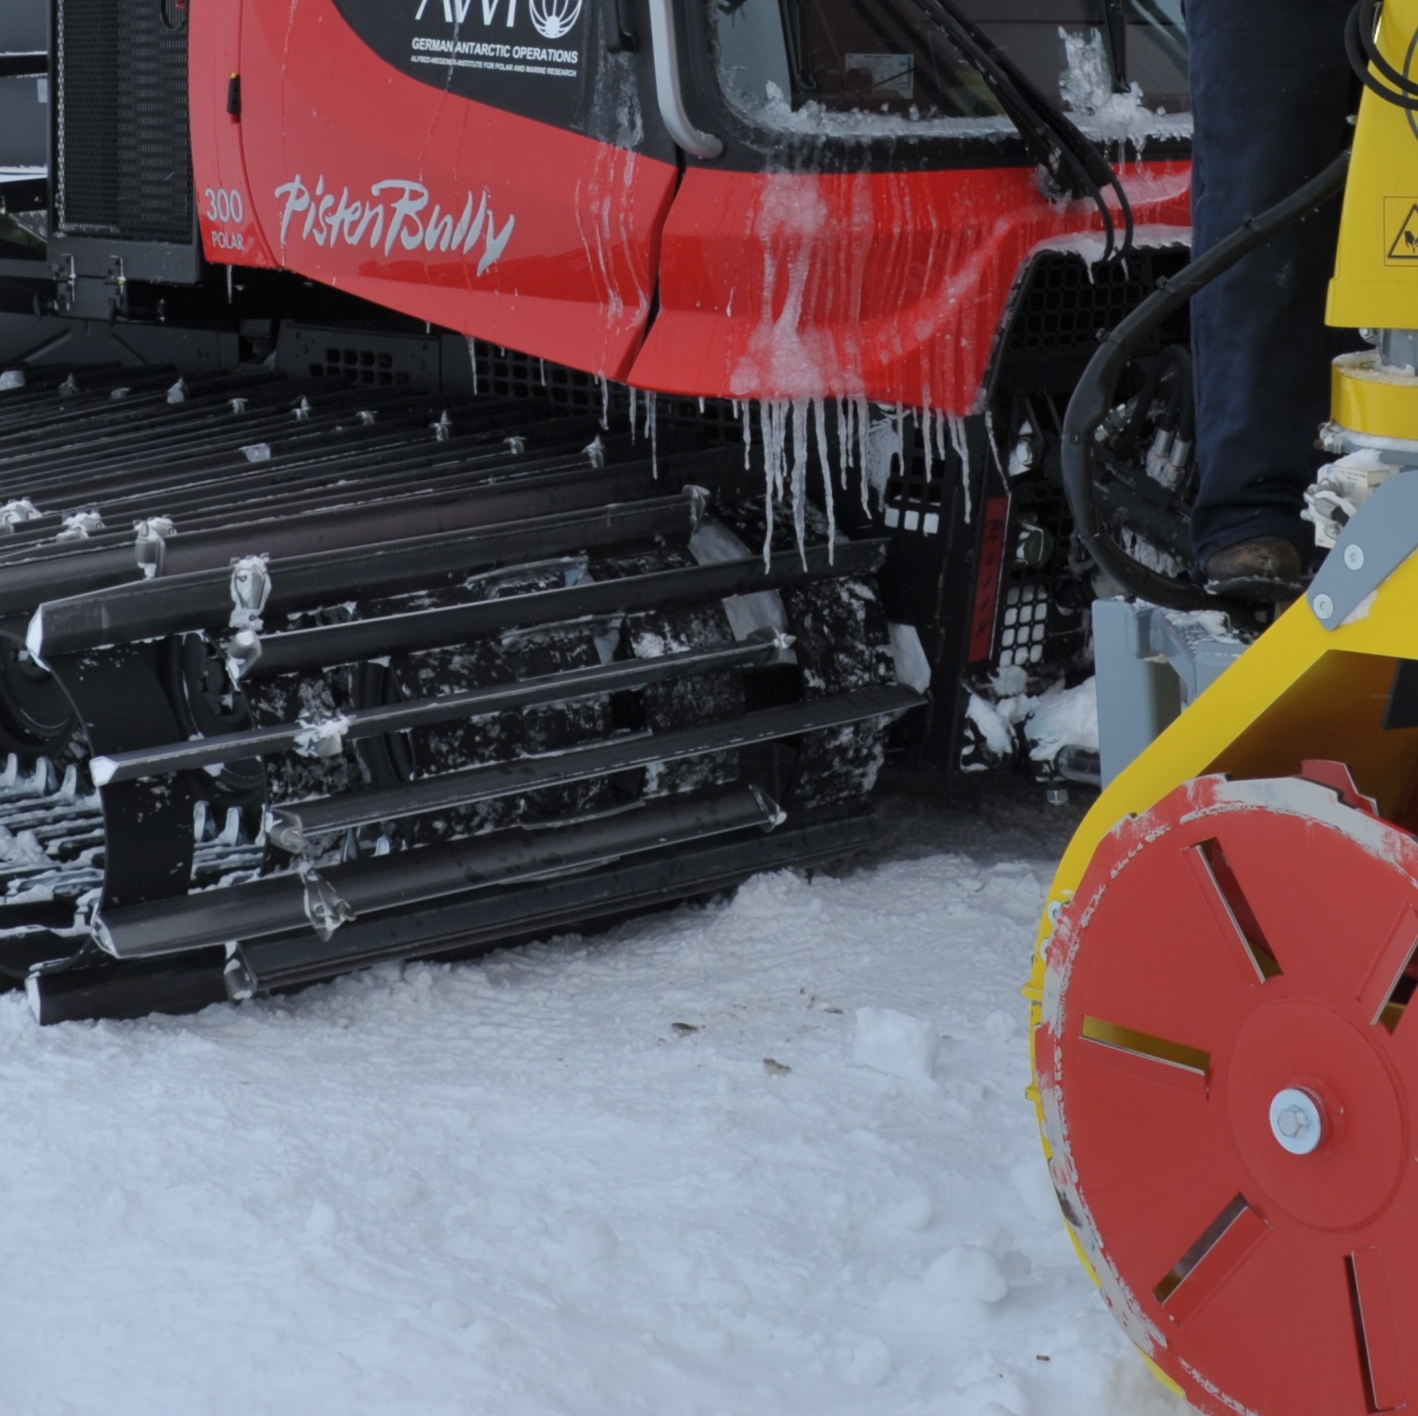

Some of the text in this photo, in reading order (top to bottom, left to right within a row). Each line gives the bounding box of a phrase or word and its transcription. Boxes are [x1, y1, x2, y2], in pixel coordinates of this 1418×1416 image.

[412, 37, 579, 64] GERMAN ANTARCTIC OPERATIONS
[205, 187, 243, 224] 300
[211, 231, 244, 251] POLAR
[275, 174, 516, 277] PistenBully
